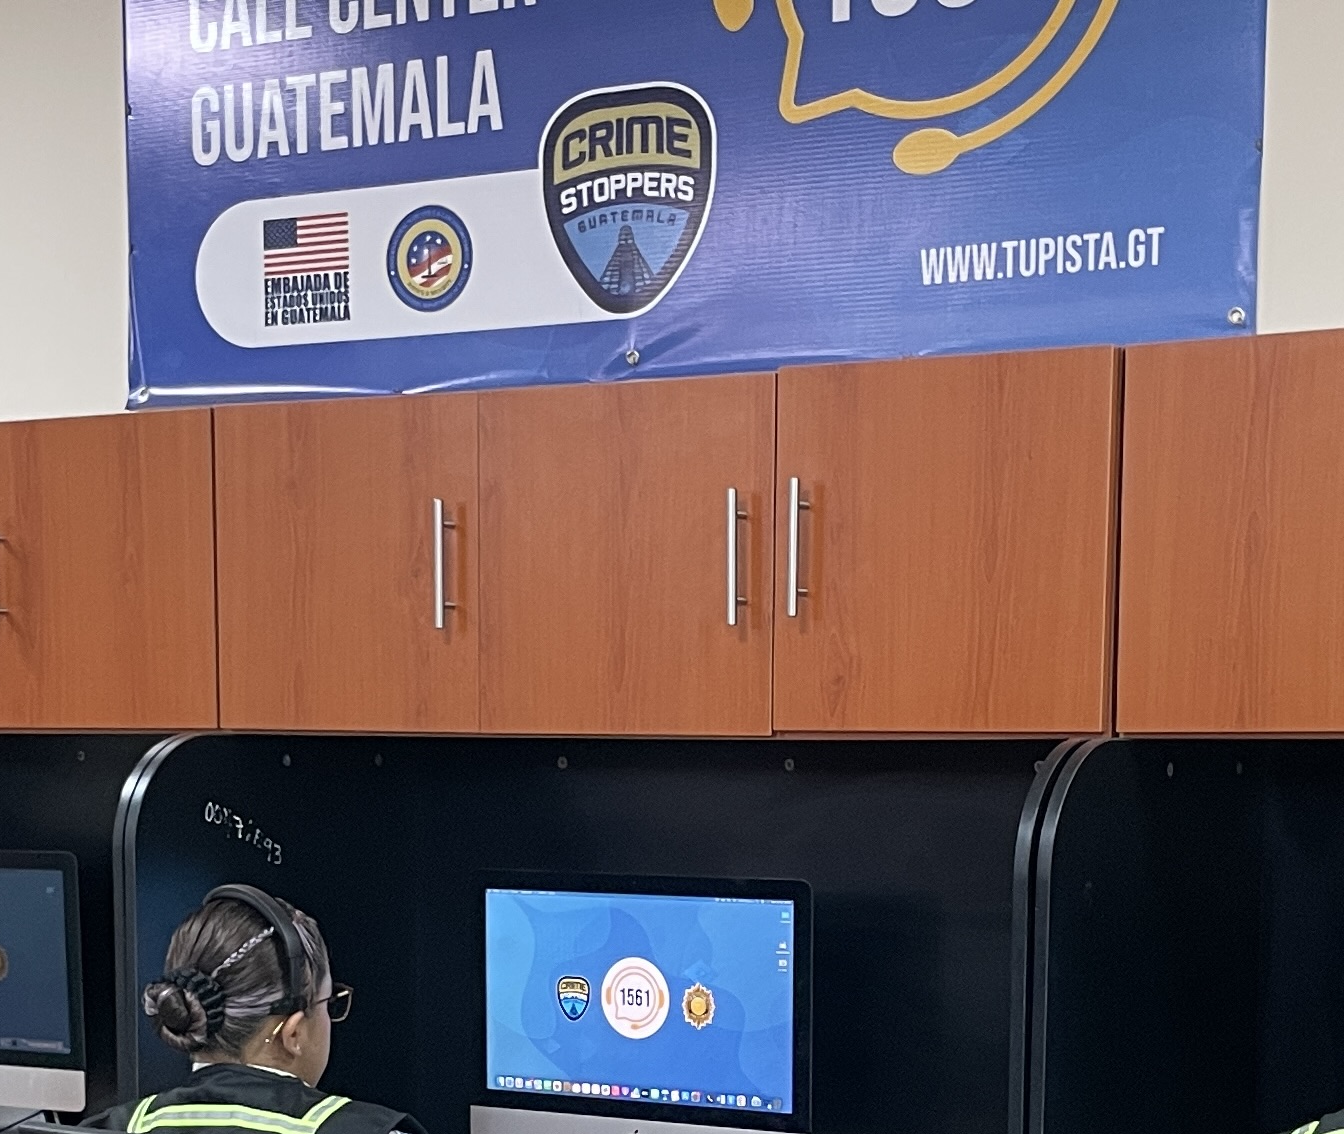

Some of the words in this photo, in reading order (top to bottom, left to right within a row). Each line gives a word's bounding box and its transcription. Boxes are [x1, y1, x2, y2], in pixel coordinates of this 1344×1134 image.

[191, 49, 503, 166] GUATEMALA
[561, 115, 692, 170] CRIME
[560, 172, 695, 215] STOPPERS
[577, 209, 677, 234] GUATEMALA
[920, 226, 1165, 286] WWW.TUPISTA.GT
[264, 273, 332, 295] EMBAJADA
[334, 271, 350, 290] DE
[264, 293, 309, 310] ESTADOS
[264, 309, 279, 327] EN
[281, 304, 351, 325] GUATEMALA
[619, 988, 650, 1008] 1561
